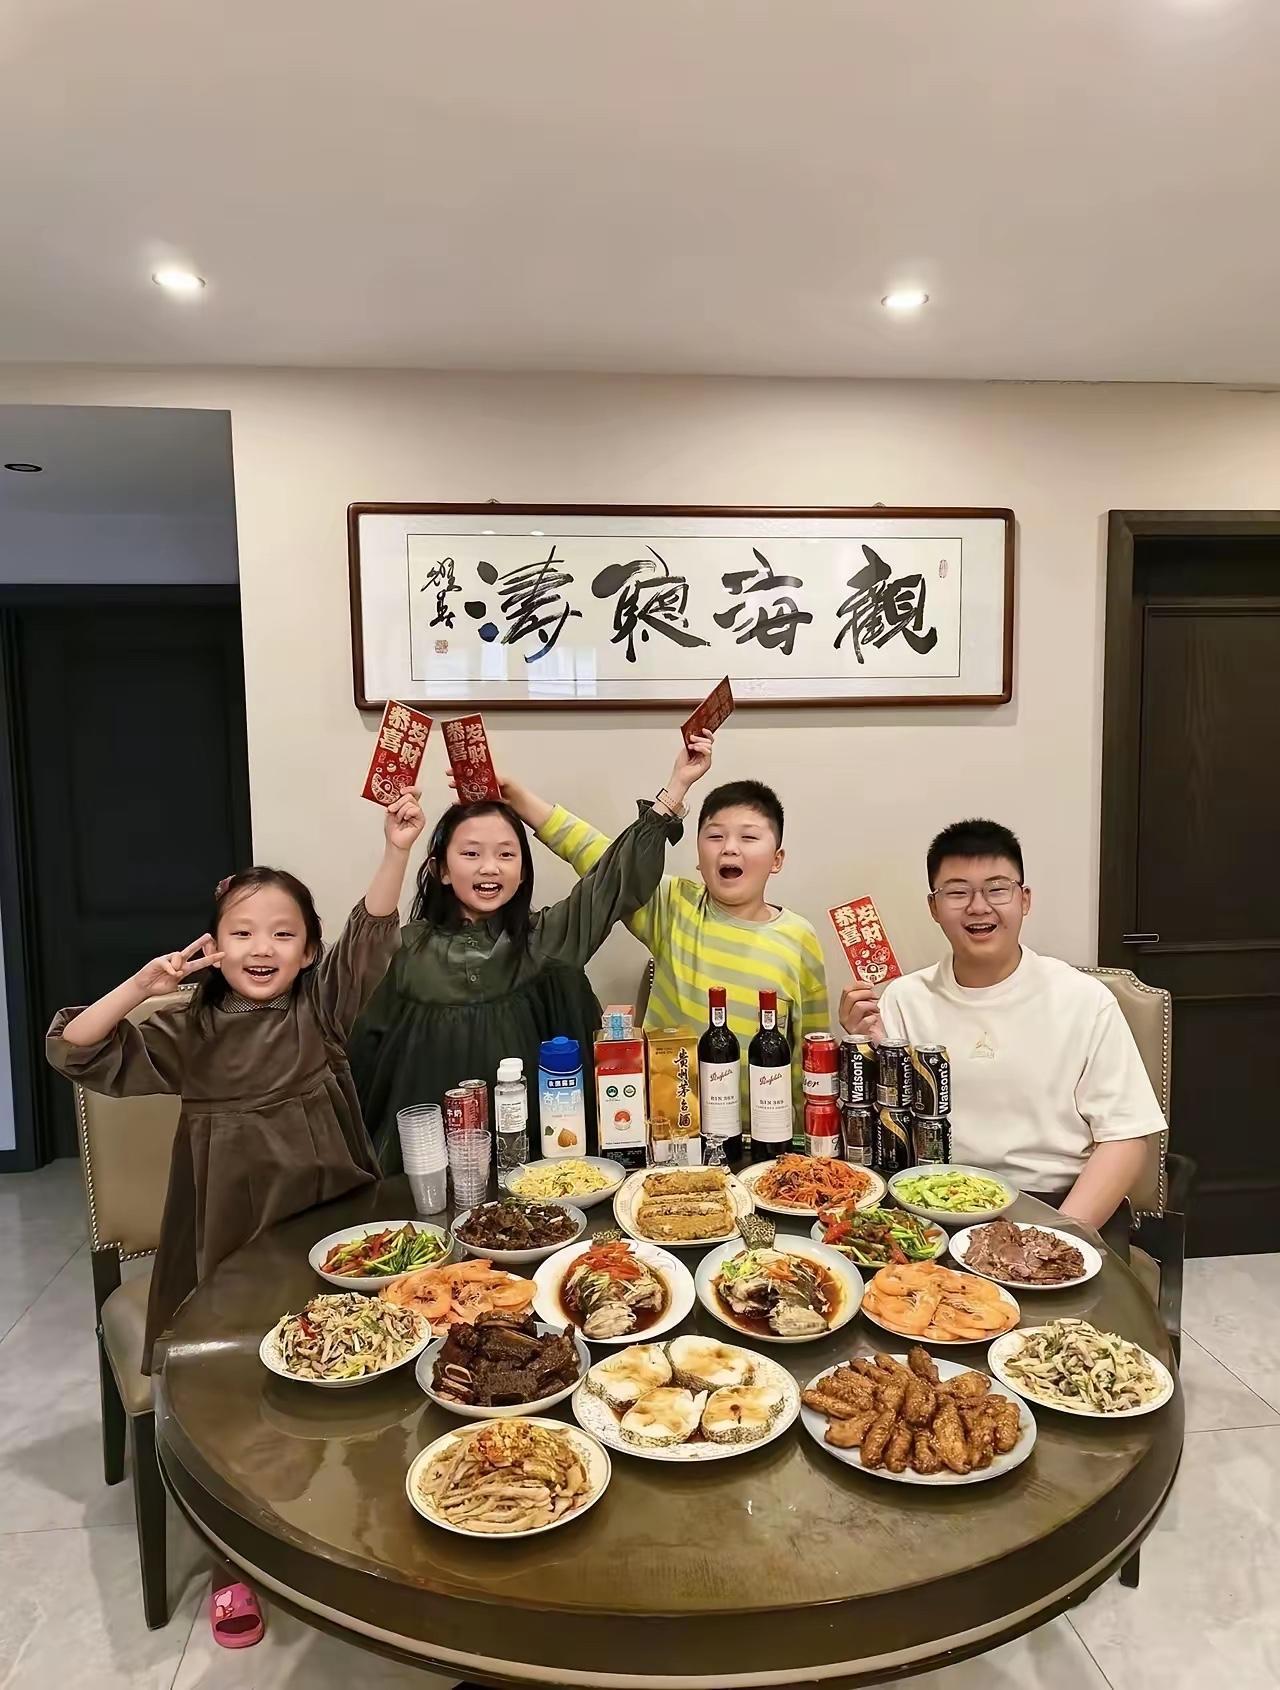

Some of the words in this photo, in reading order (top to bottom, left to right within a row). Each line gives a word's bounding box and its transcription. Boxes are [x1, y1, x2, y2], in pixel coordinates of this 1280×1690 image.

[380, 705, 411, 753] 恭喜
[399, 721, 429, 769] 发财
[446, 721, 468, 762] 恭喜
[465, 723, 487, 767] 发财
[834, 905, 862, 947] 恭喜
[855, 904, 883, 945] 发财
[852, 1054, 863, 1102] Watson's
[901, 1056, 912, 1106] Watson's
[938, 1062, 949, 1114] Watson's
